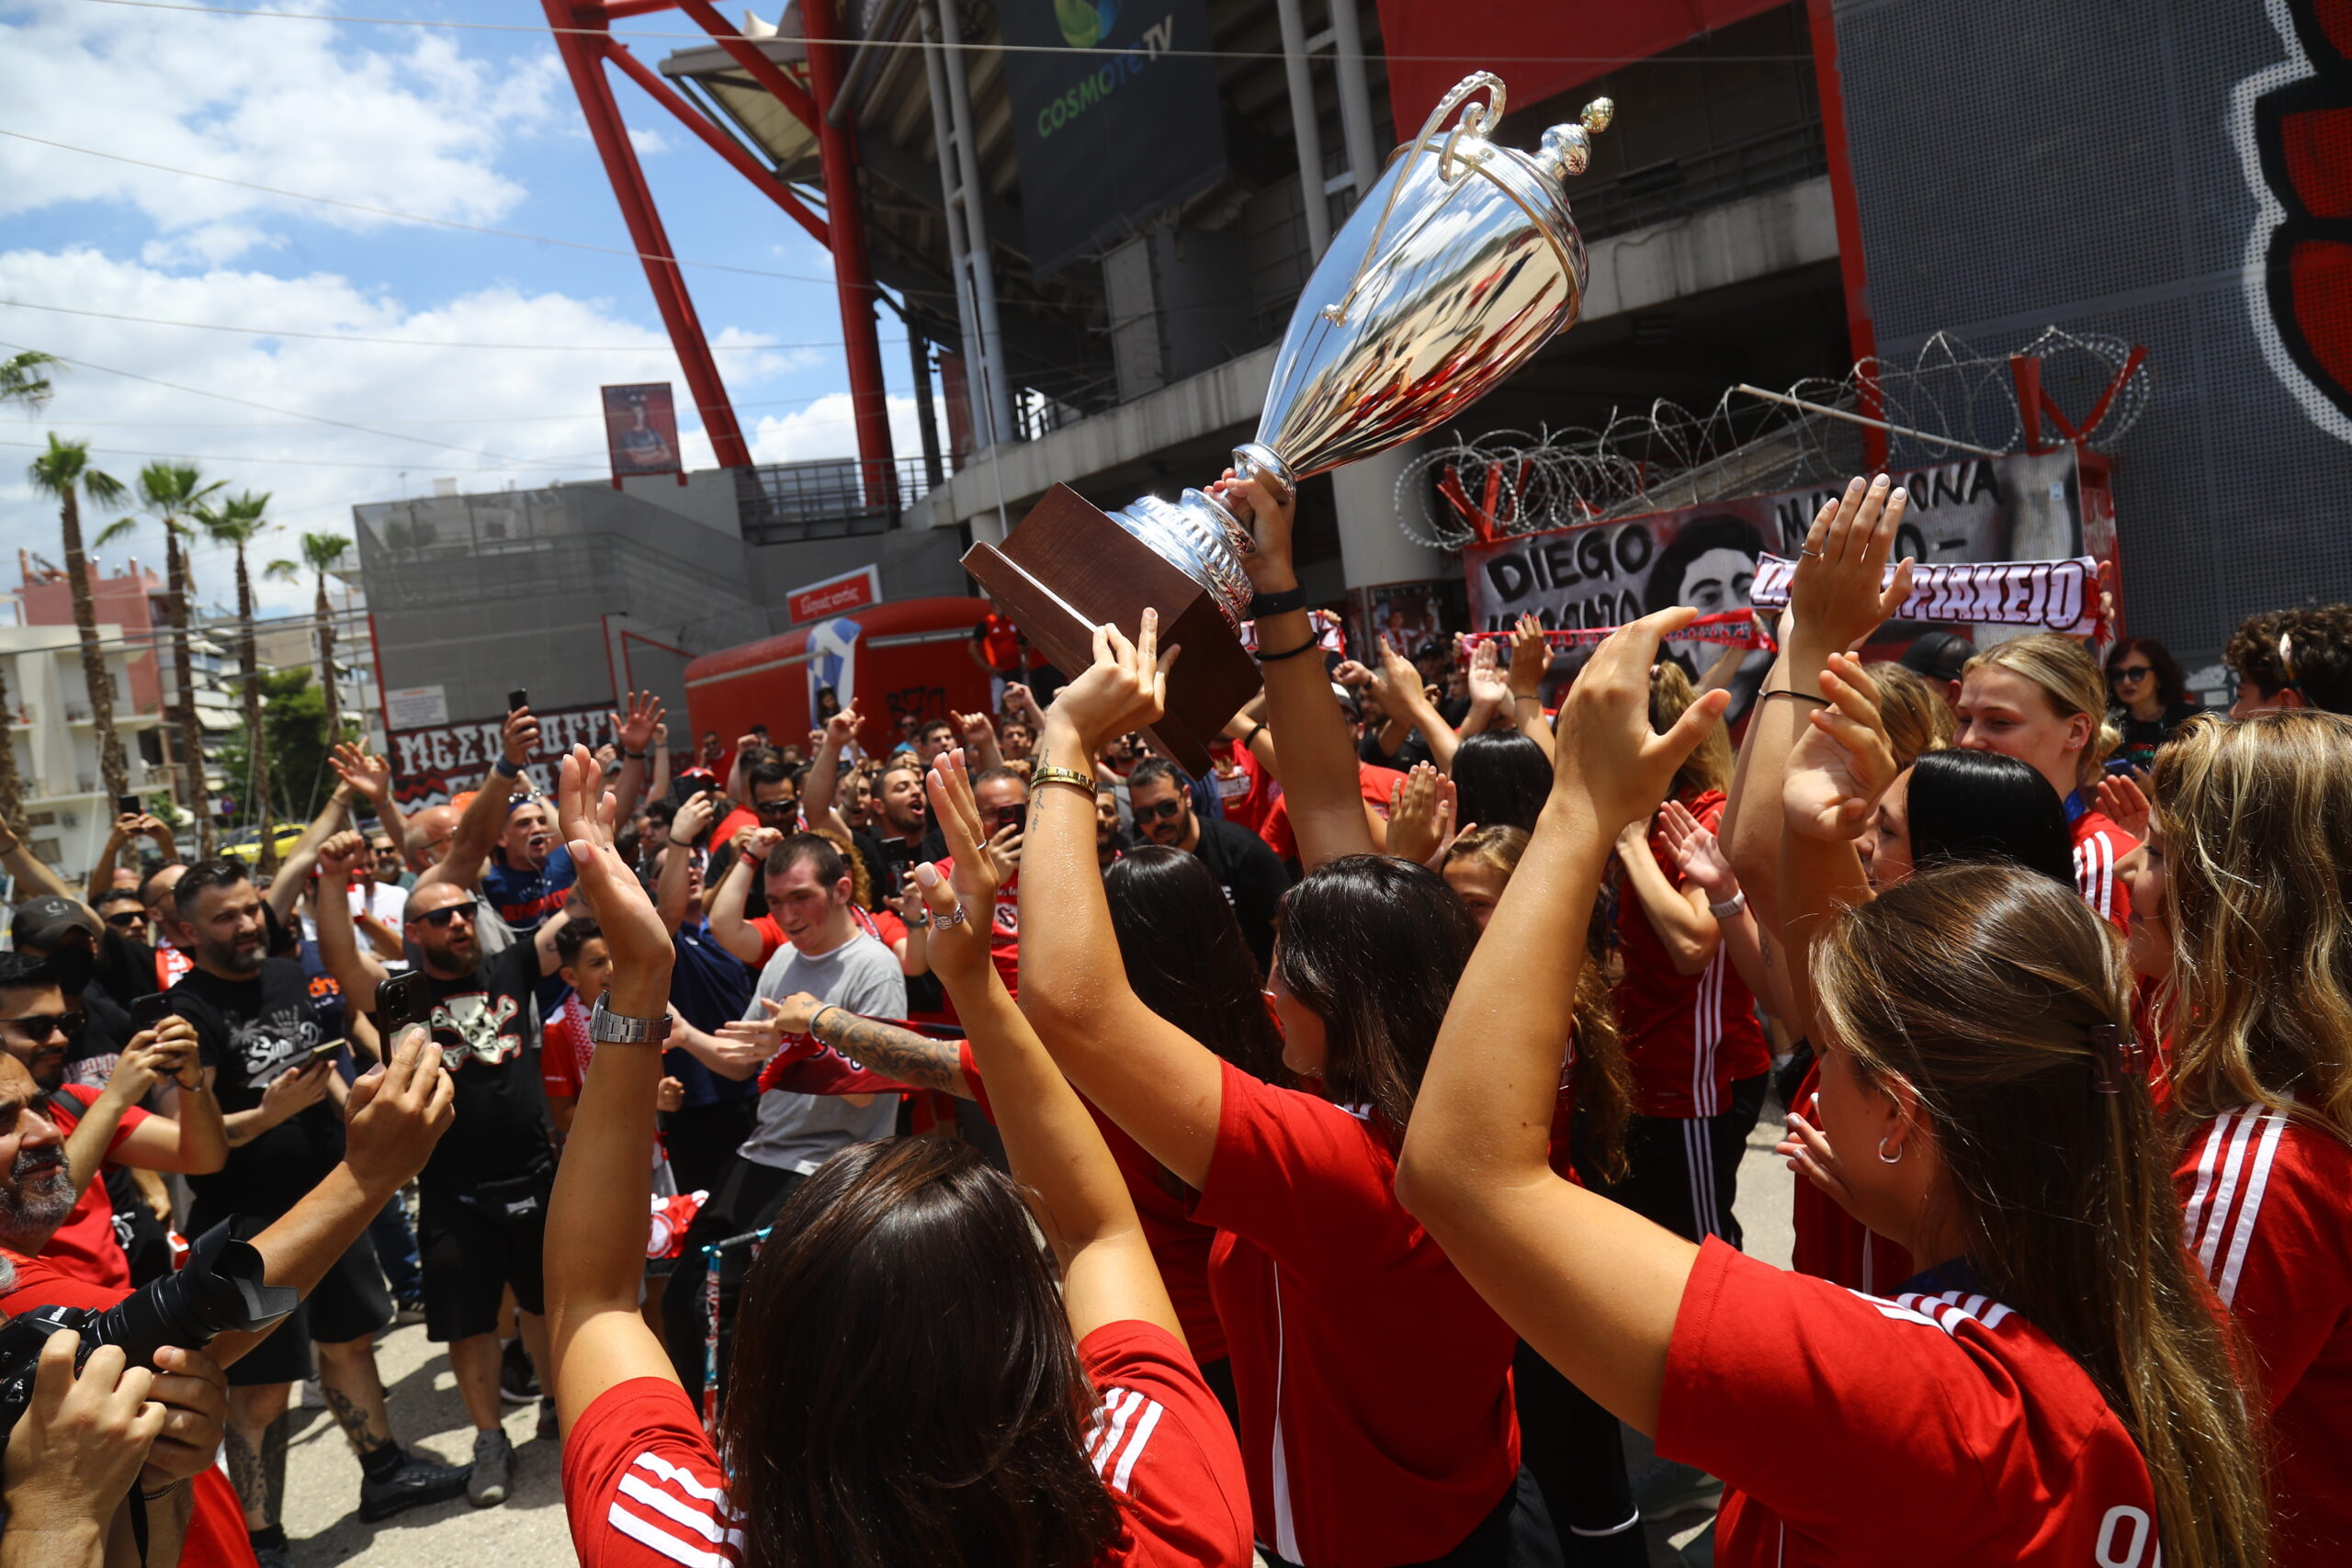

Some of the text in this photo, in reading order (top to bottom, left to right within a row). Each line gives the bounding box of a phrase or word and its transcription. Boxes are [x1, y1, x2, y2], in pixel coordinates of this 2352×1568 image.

[1038, 14, 1173, 138] COSMOTE TV
[1486, 524, 1653, 604] DIEGO
